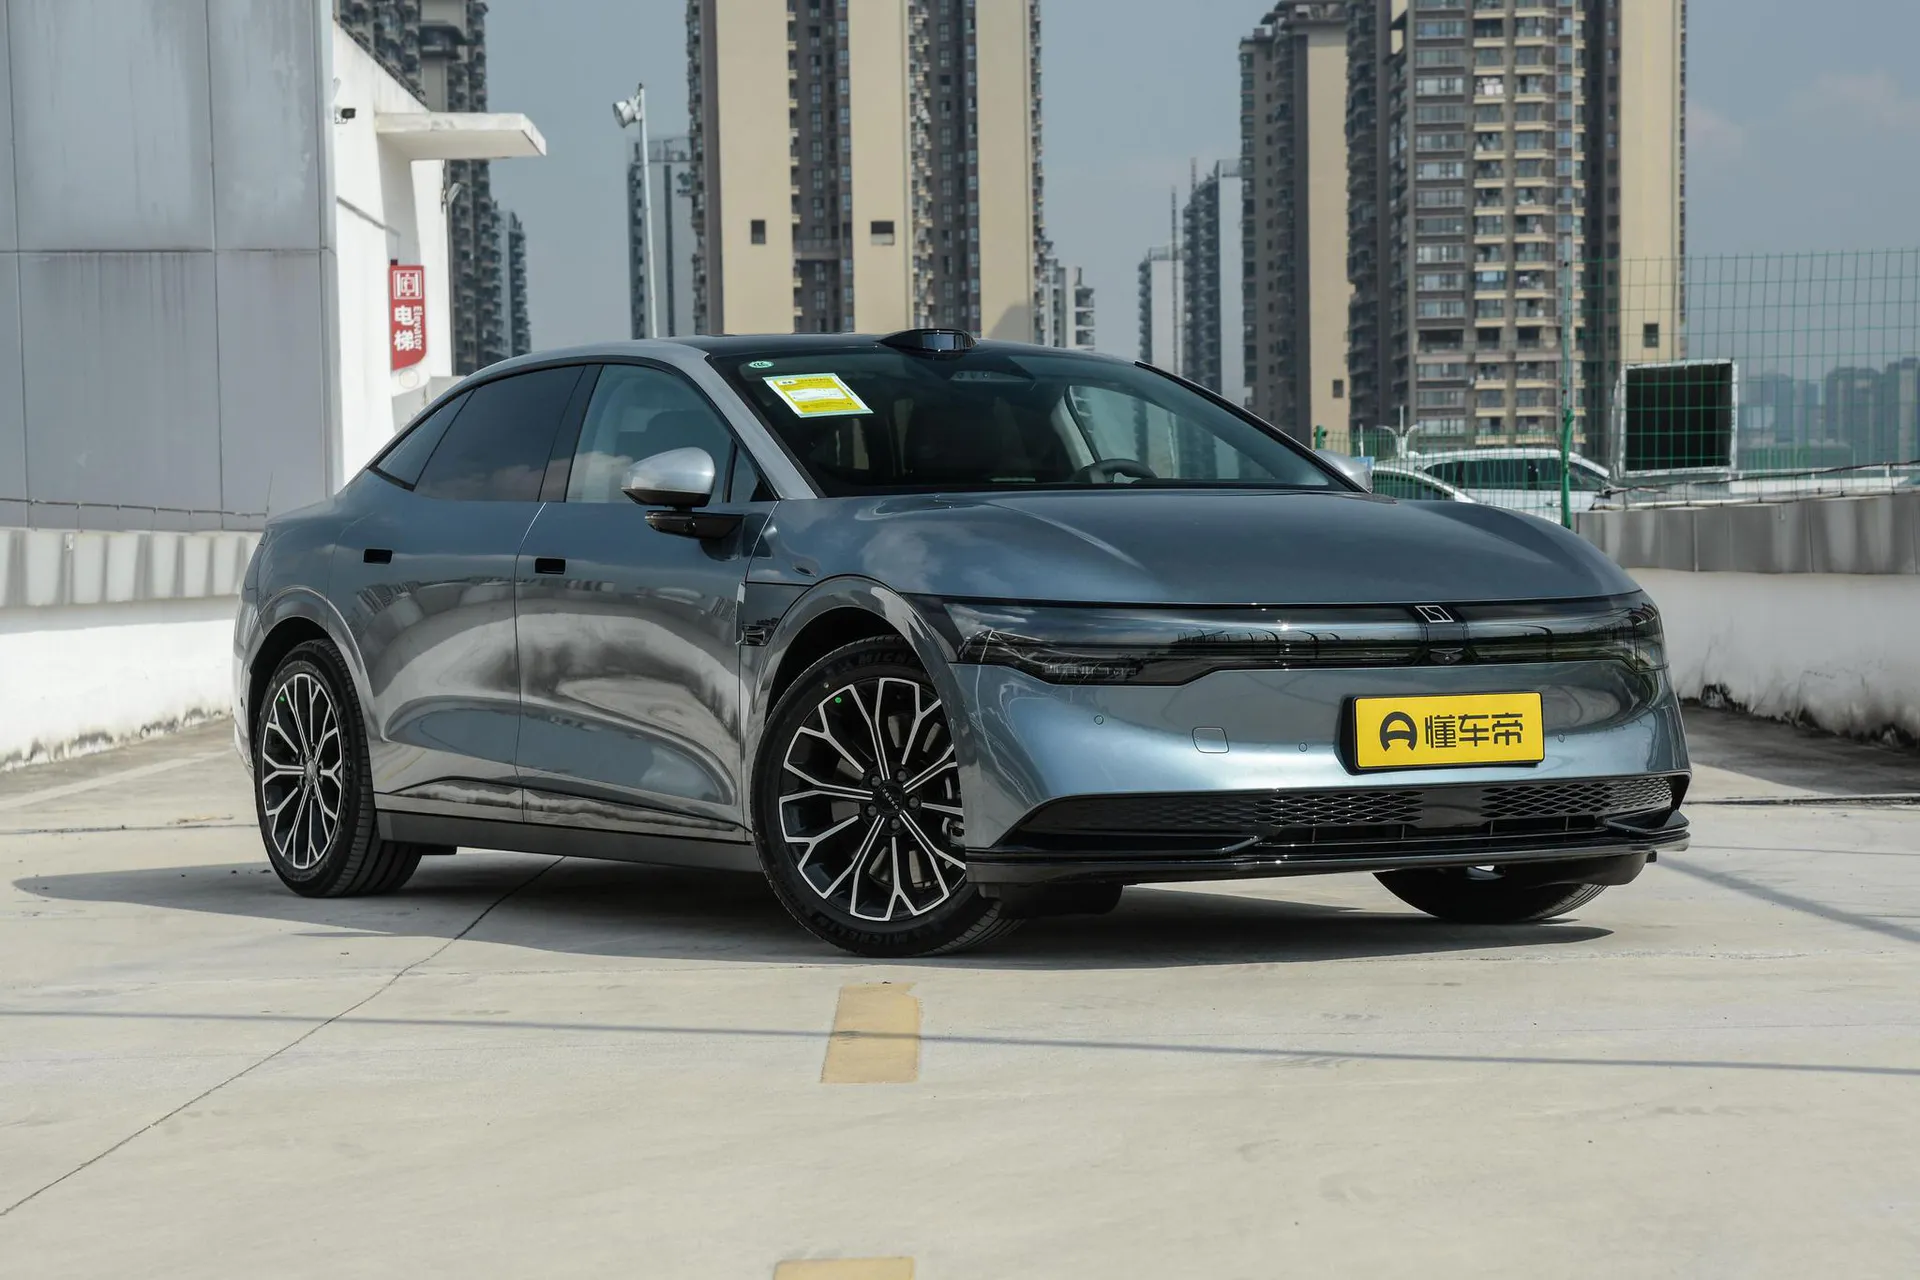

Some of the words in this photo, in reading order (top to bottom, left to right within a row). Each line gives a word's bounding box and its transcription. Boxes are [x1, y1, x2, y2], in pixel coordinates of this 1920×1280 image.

[394, 305, 414, 351] 电梯
[414, 305, 423, 350] Elevator
[1424, 712, 1523, 748] 懂车帝
